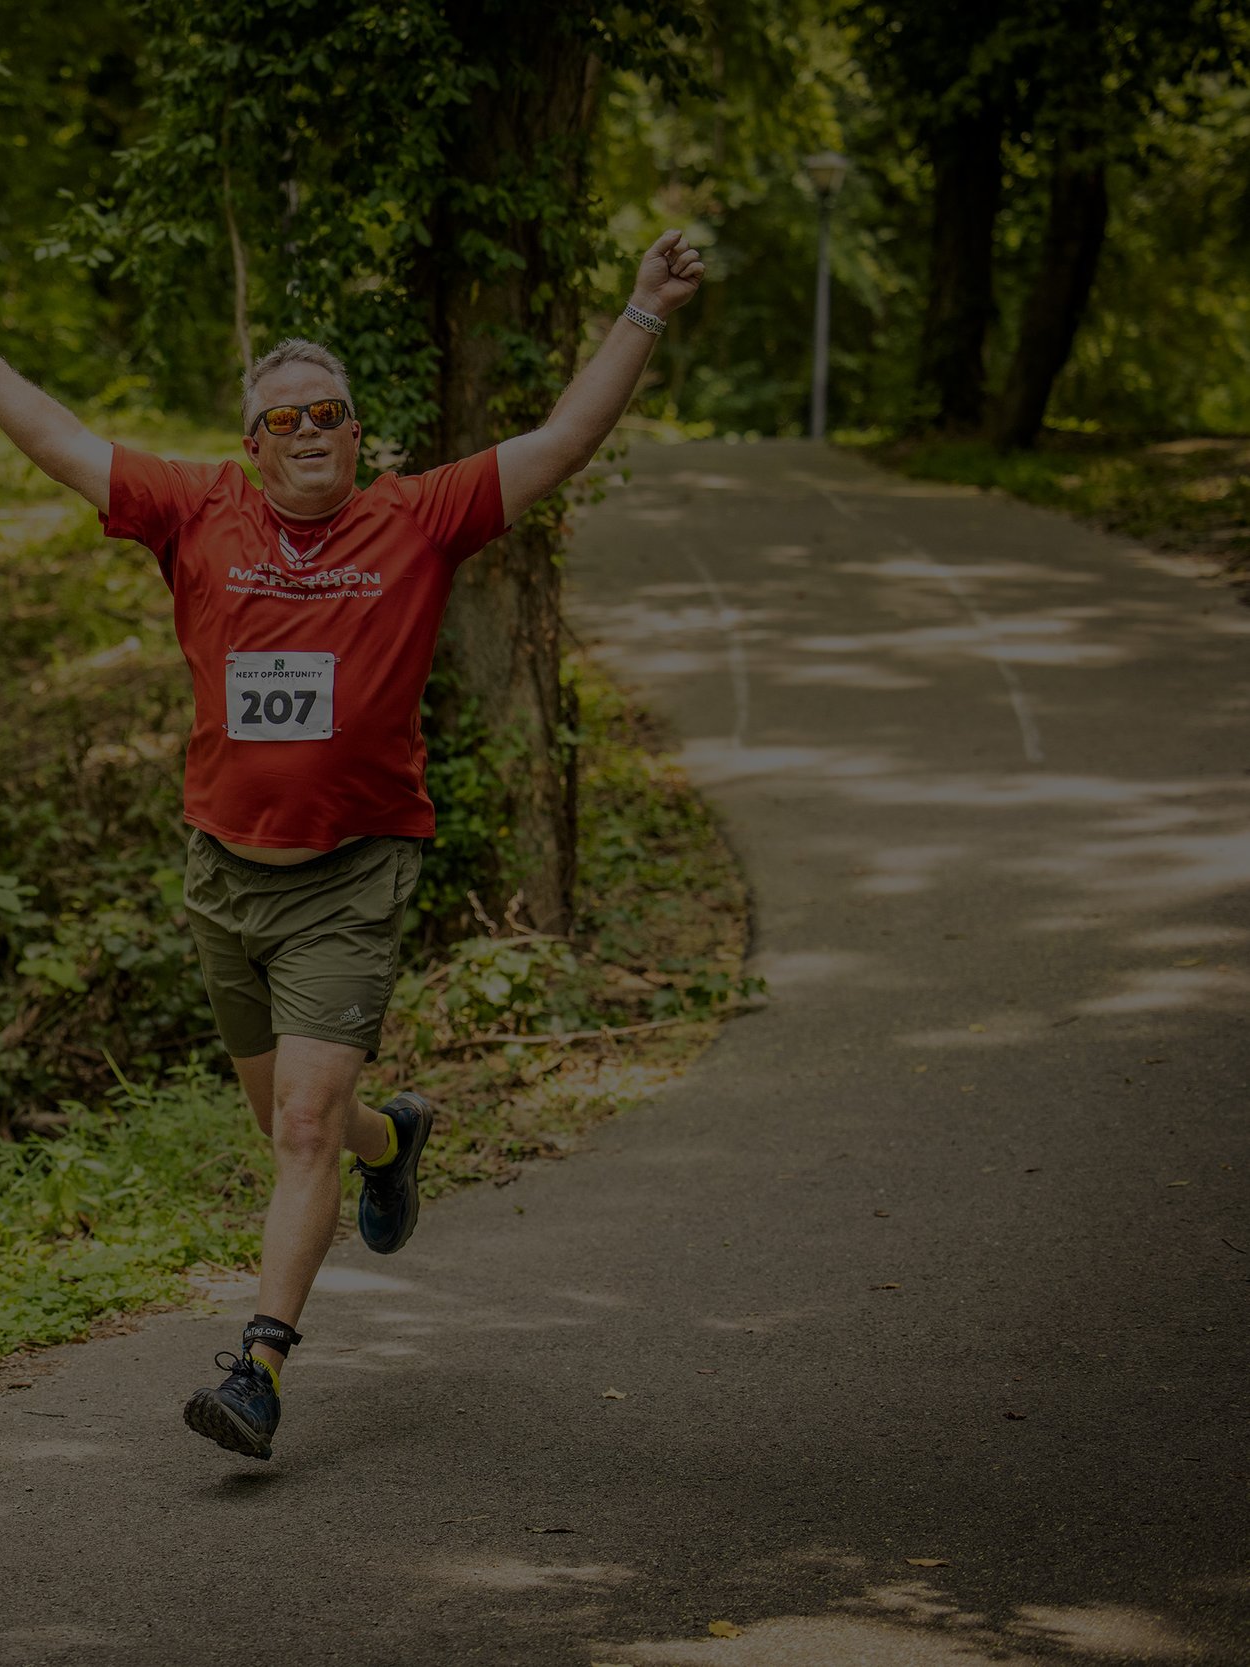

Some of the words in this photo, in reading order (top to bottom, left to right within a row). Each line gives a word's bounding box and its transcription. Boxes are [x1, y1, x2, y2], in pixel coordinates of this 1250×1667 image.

[228, 566, 381, 589] MARATHON
[226, 585, 305, 600] WRIGHT-PATTERSON
[362, 589, 382, 597] OHIO
[236, 671, 259, 679] NEXT
[261, 671, 322, 679] OPPORTUNITY
[241, 690, 317, 725] 207
[339, 1014, 365, 1023] adidas
